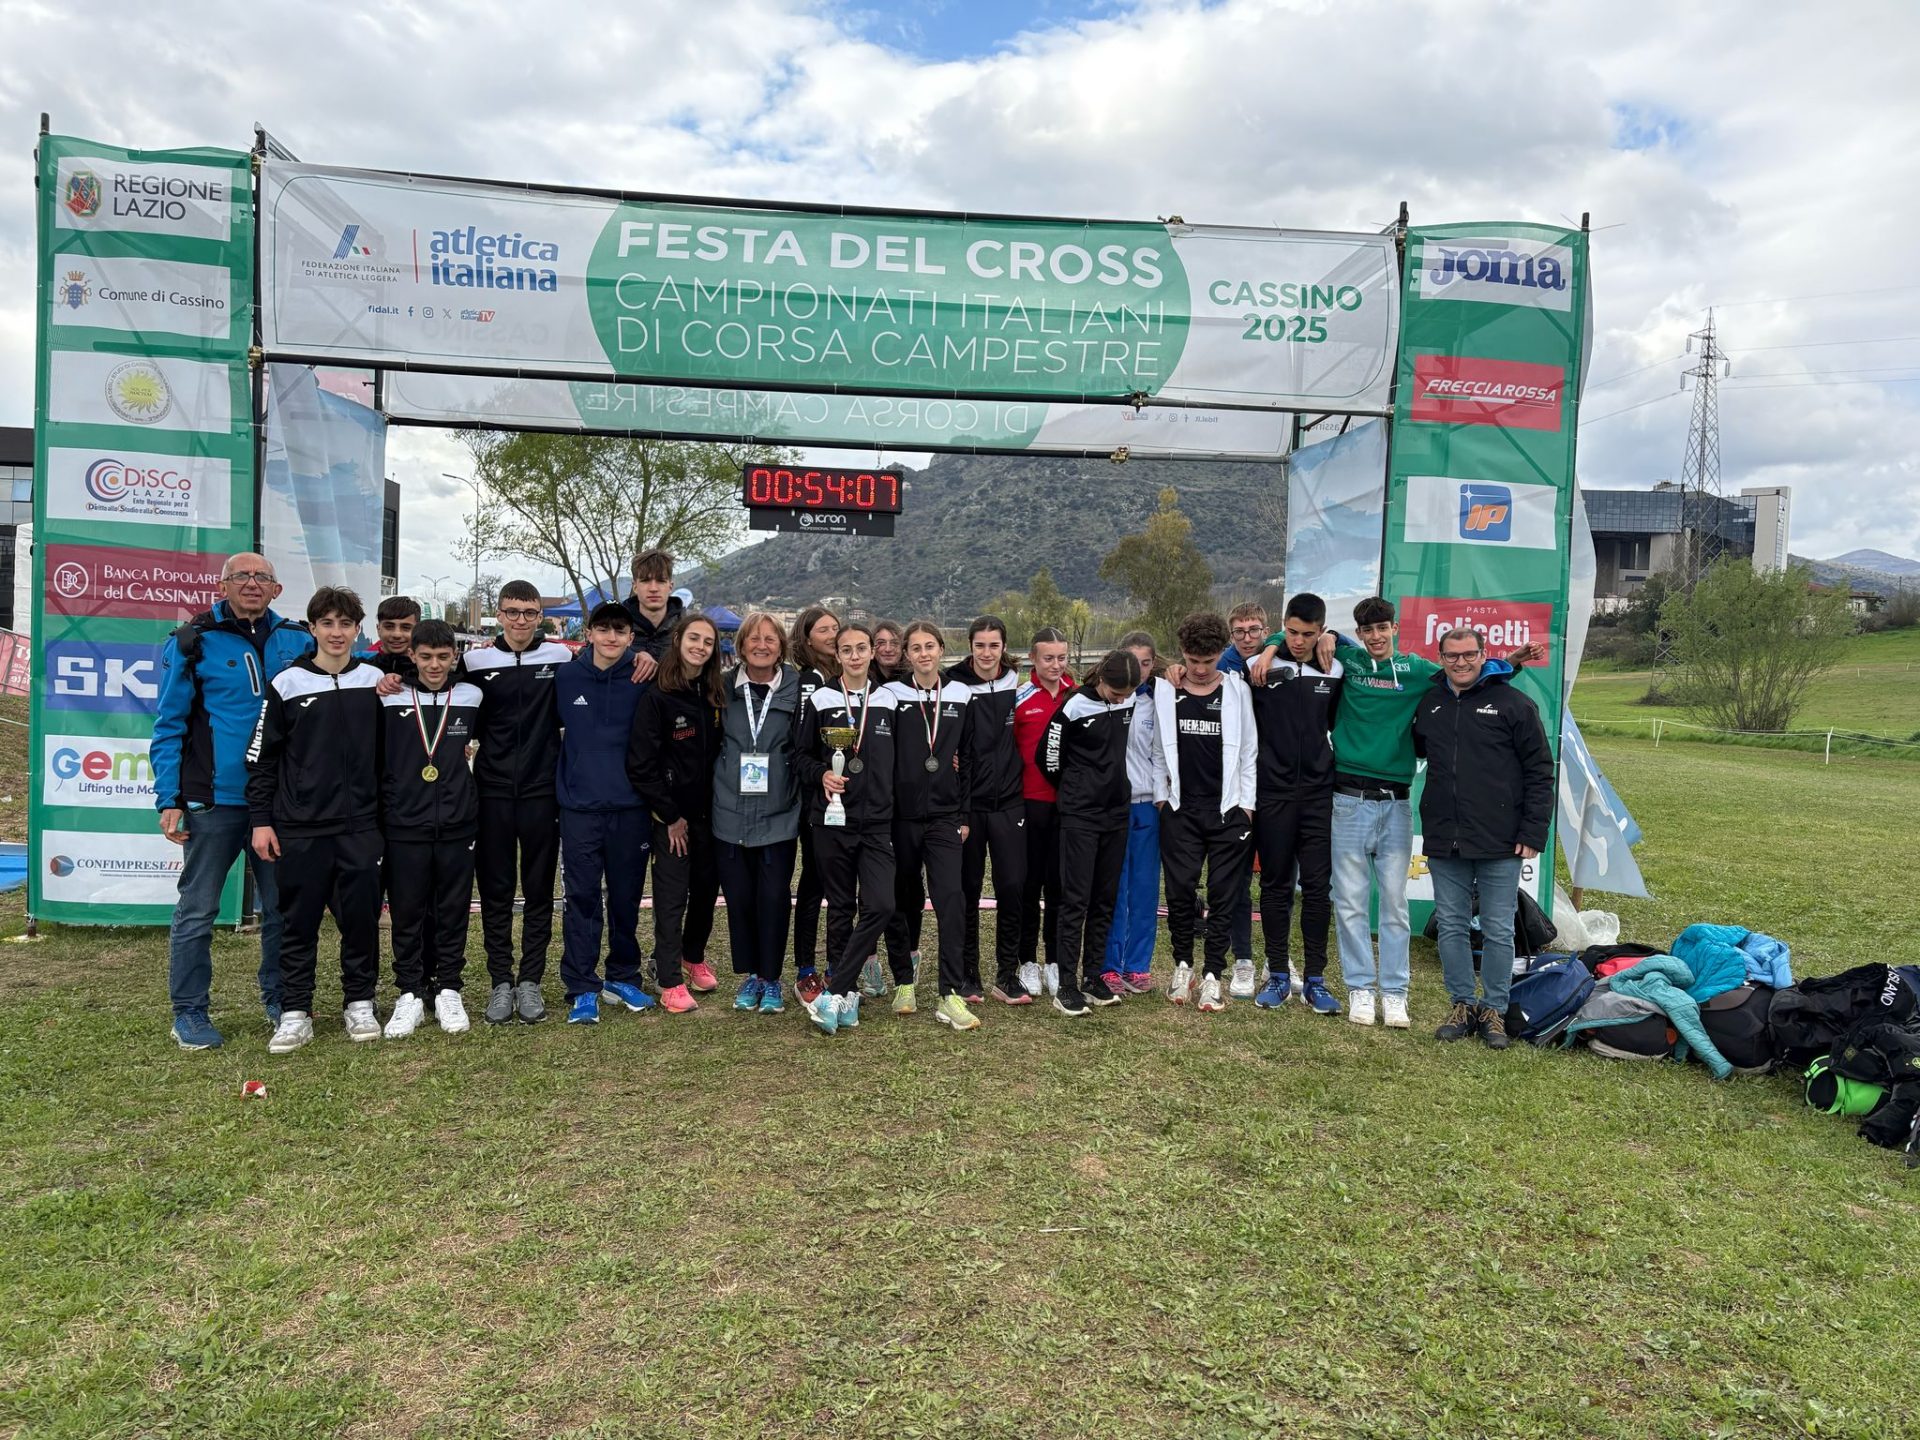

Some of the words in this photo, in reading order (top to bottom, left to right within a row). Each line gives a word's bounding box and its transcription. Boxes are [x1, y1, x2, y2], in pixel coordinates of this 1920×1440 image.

[113, 173, 222, 202] REGIONE
[113, 196, 187, 220] LAZIO
[429, 225, 559, 262] atletica
[617, 220, 808, 267] FESTA
[829, 231, 946, 275] DEL
[965, 238, 1164, 289] CROSS
[301, 260, 361, 272] FEDERAZIONE
[363, 266, 400, 274] ITALIANA
[317, 272, 358, 280] ATLETICA
[361, 274, 398, 283] LEGGERA
[430, 253, 558, 292] italiana
[98, 287, 148, 302] Comune
[151, 290, 165, 303] di
[169, 291, 225, 310] Cassino
[614, 272, 936, 326] CAMPIONATI
[961, 292, 1164, 336] ITALIANI
[1208, 279, 1363, 312] CASSINO
[368, 305, 400, 315] fidal.it
[1241, 312, 1329, 344] 2025
[617, 316, 661, 355] DI
[681, 319, 853, 365] CORSA
[871, 331, 1162, 377] CAMPESTRE
[1425, 378, 1557, 402] FRECCIAROSSA
[124, 467, 192, 491] DiSCo
[751, 468, 898, 507] 00:54:07
[132, 488, 190, 500] LAZIO
[104, 564, 149, 582] BANCA
[104, 583, 124, 600] del
[127, 582, 221, 605] CASSINATE
[1466, 606, 1498, 616] PASTA
[54, 656, 158, 699] SK
[1178, 718, 1221, 732] PIEMONTE
[52, 747, 156, 781] Gem
[79, 782, 113, 795] Lifting
[115, 784, 134, 794] the
[137, 784, 156, 795] Mo
